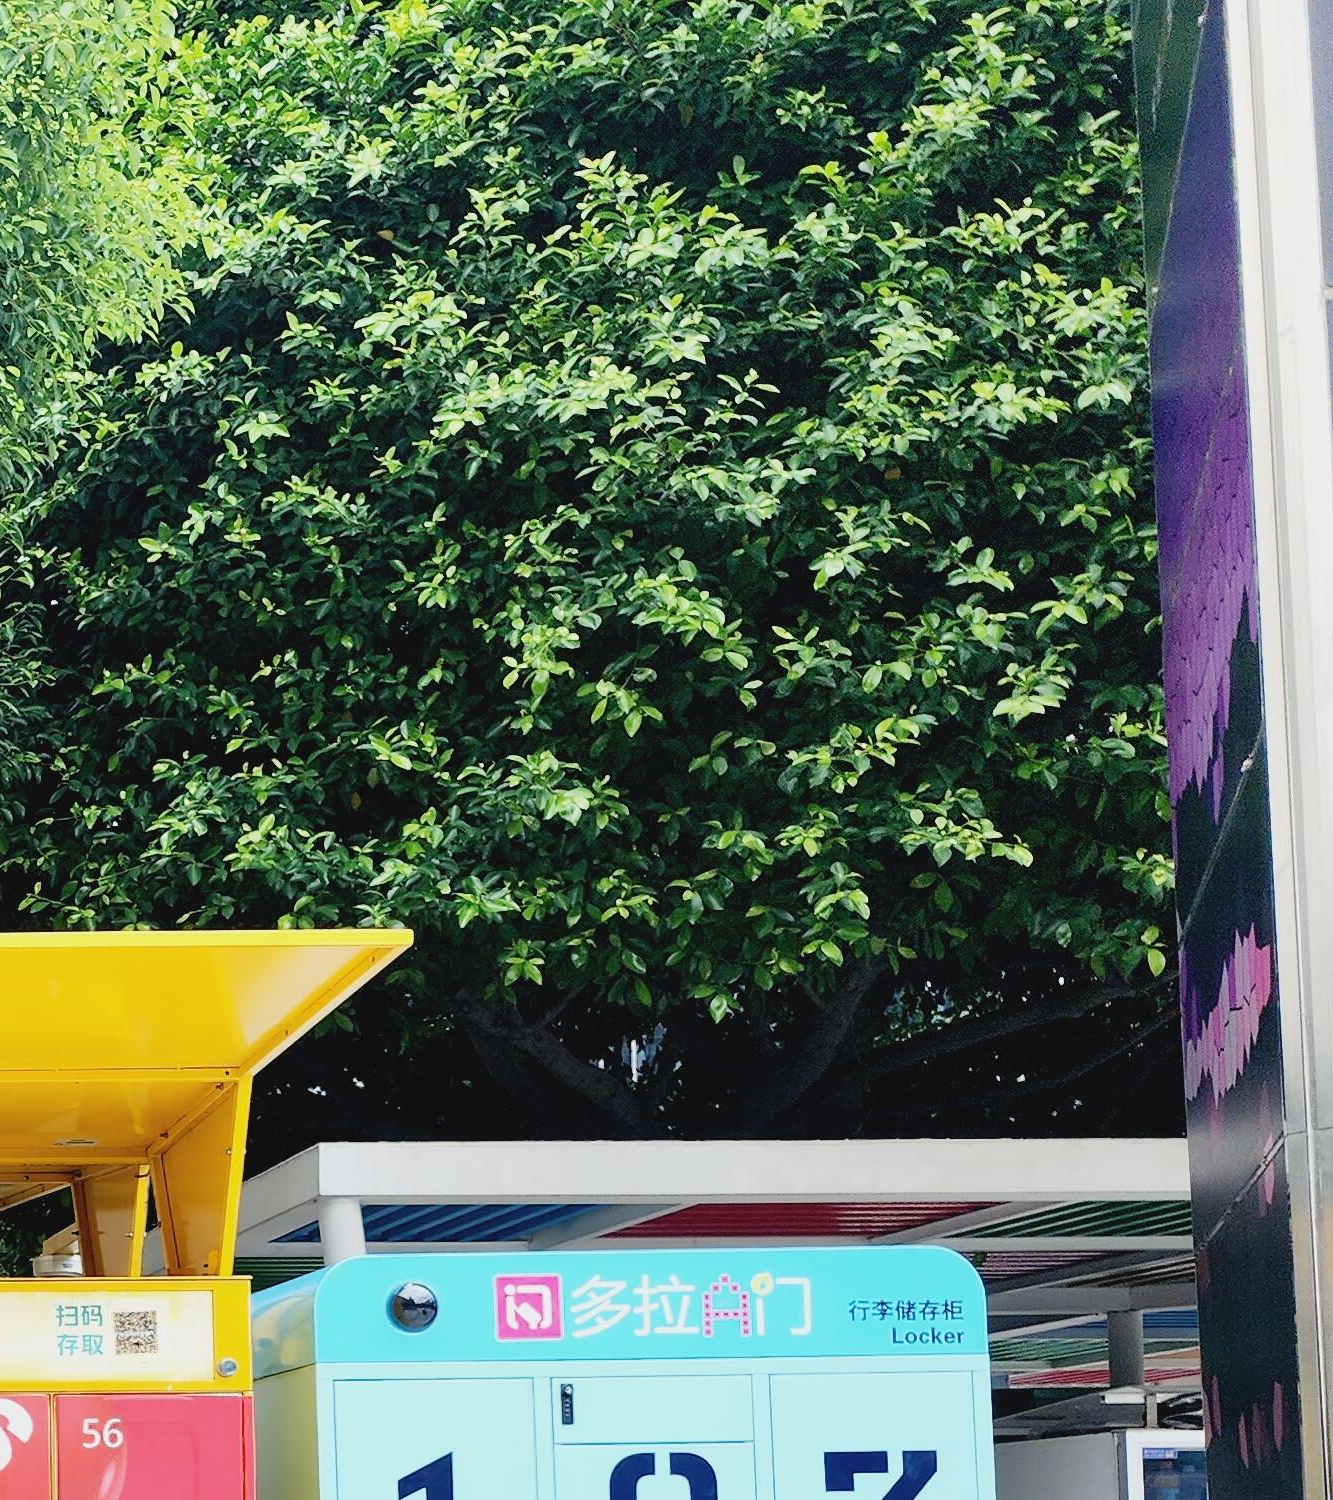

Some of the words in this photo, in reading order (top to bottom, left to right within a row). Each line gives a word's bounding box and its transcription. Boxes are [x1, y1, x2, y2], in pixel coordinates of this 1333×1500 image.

[56, 1304, 103, 1328] 扫码
[848, 1299, 964, 1321] 行李储存柜
[56, 1333, 104, 1356] 存取
[891, 1327, 965, 1346] Locker
[82, 1418, 124, 1449] 56
